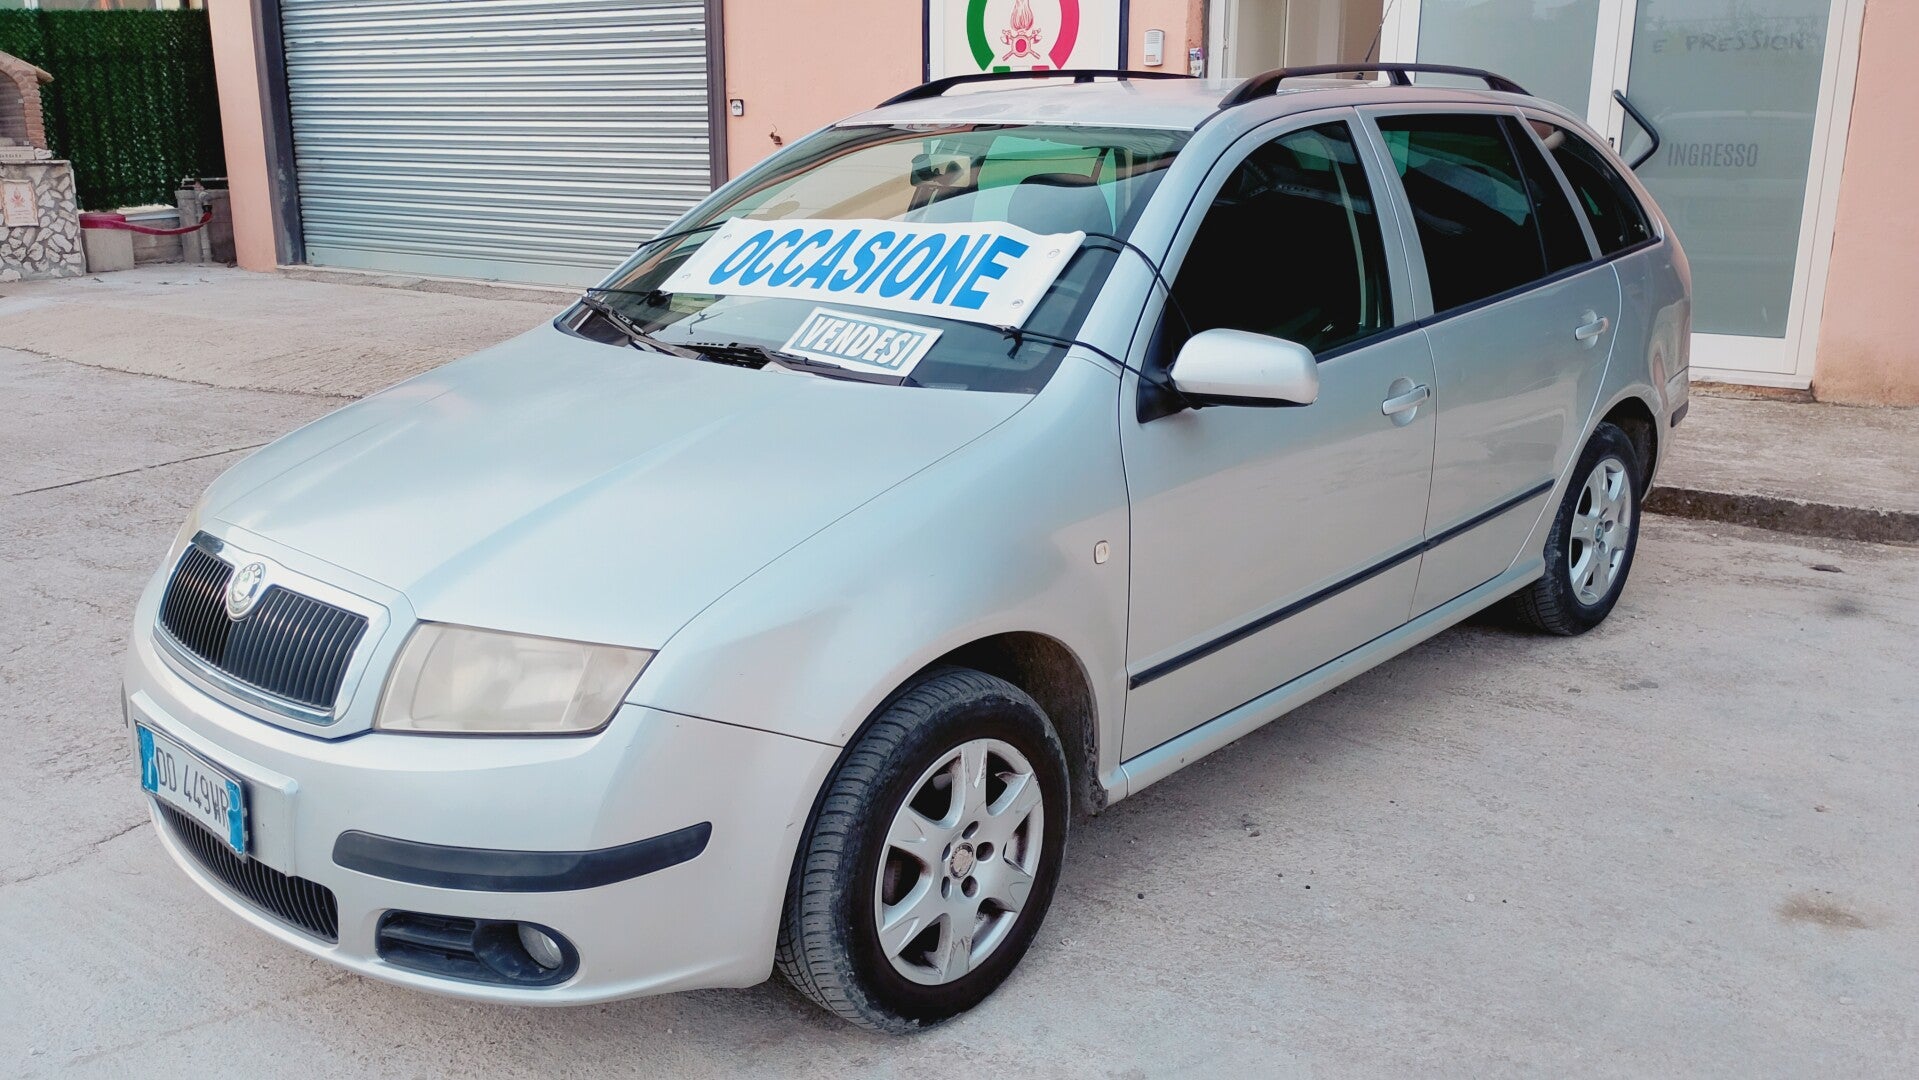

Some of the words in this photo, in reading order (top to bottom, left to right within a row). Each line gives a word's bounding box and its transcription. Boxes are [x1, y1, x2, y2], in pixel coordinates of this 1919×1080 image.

[1668, 143, 1759, 168] INGRESSO
[707, 228, 1030, 310] OCCASIONE
[799, 316, 922, 367] VENDESI
